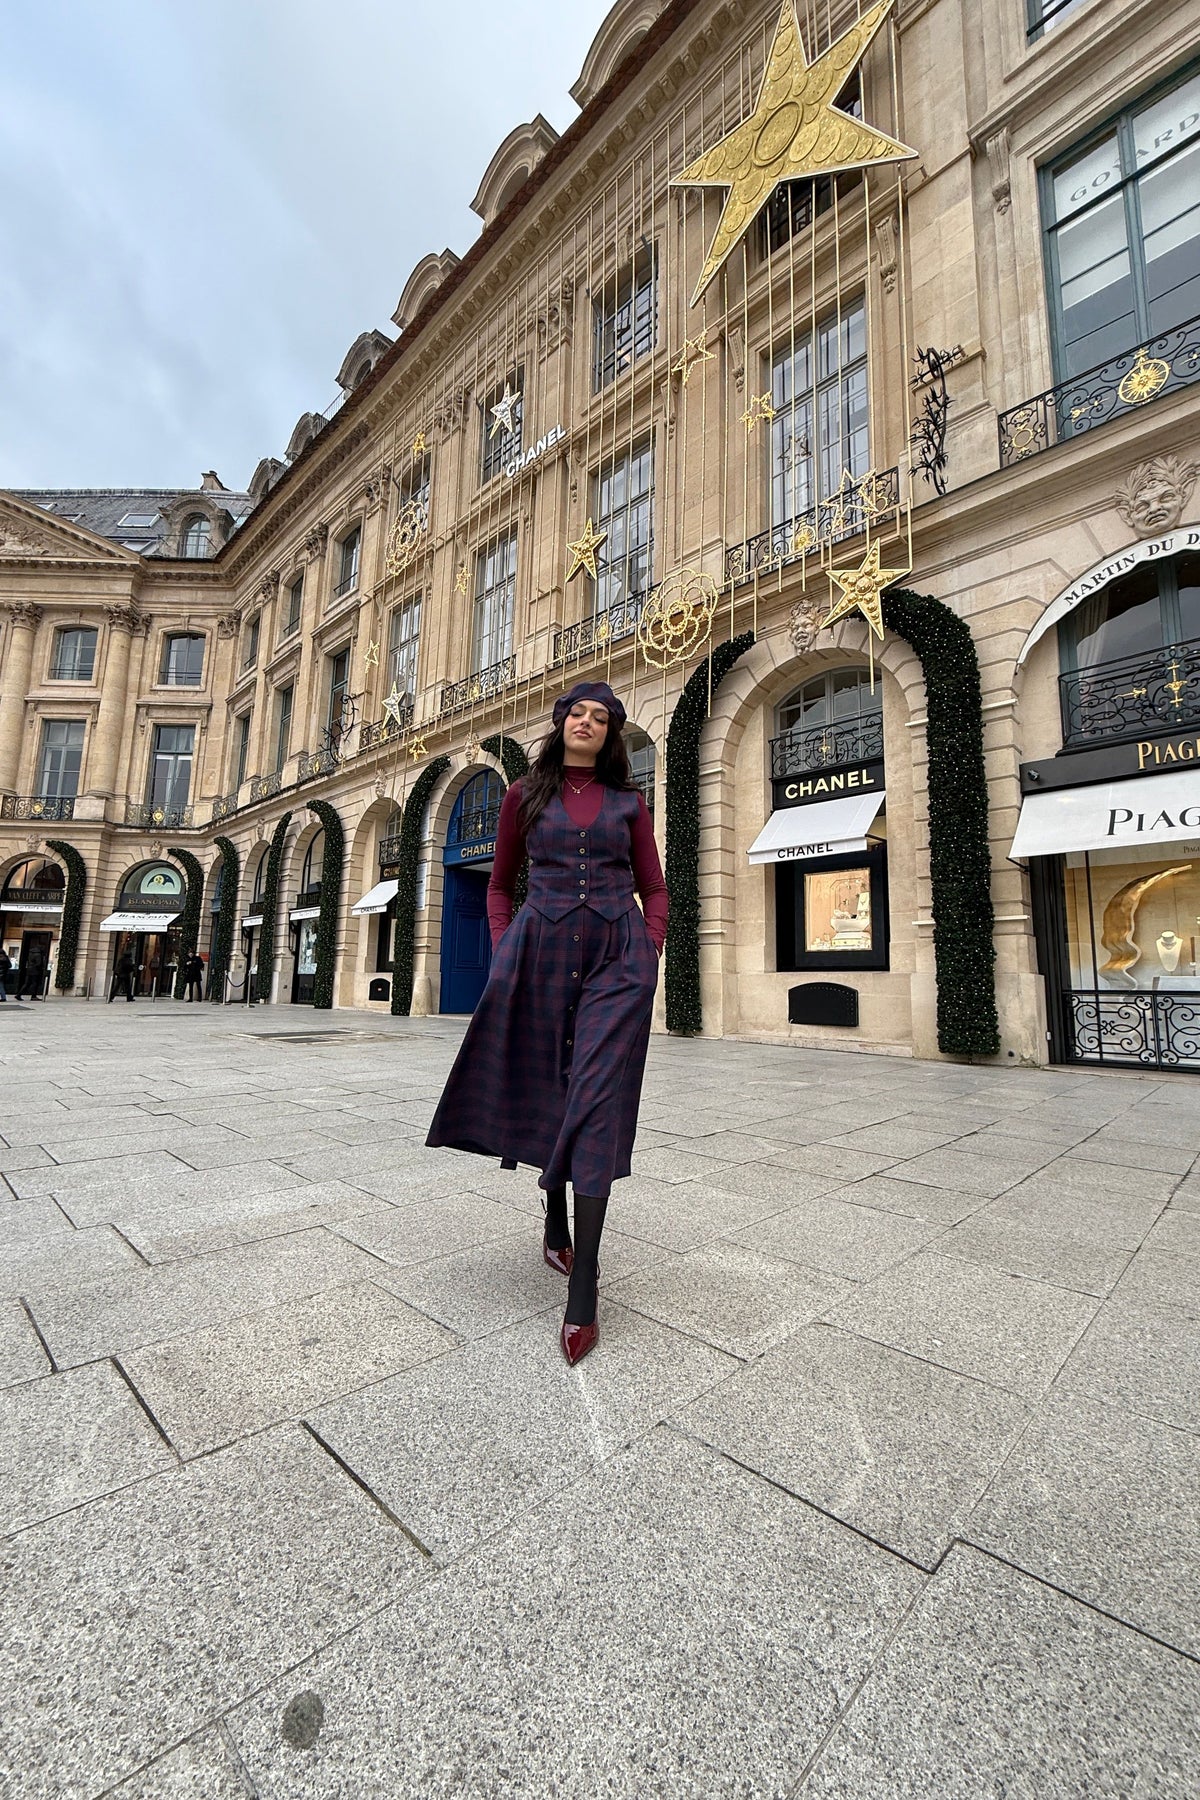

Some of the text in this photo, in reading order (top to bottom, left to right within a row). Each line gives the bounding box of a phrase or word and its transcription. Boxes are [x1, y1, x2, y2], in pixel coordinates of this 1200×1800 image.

[1070, 113, 1200, 202] GOARD
[506, 424, 566, 478] CHANEL
[1064, 533, 1200, 606] MARTIN DU D
[785, 769, 875, 799] CHANEL
[777, 842, 833, 858] CHANEL
[128, 897, 180, 905] BLANCPAIN
